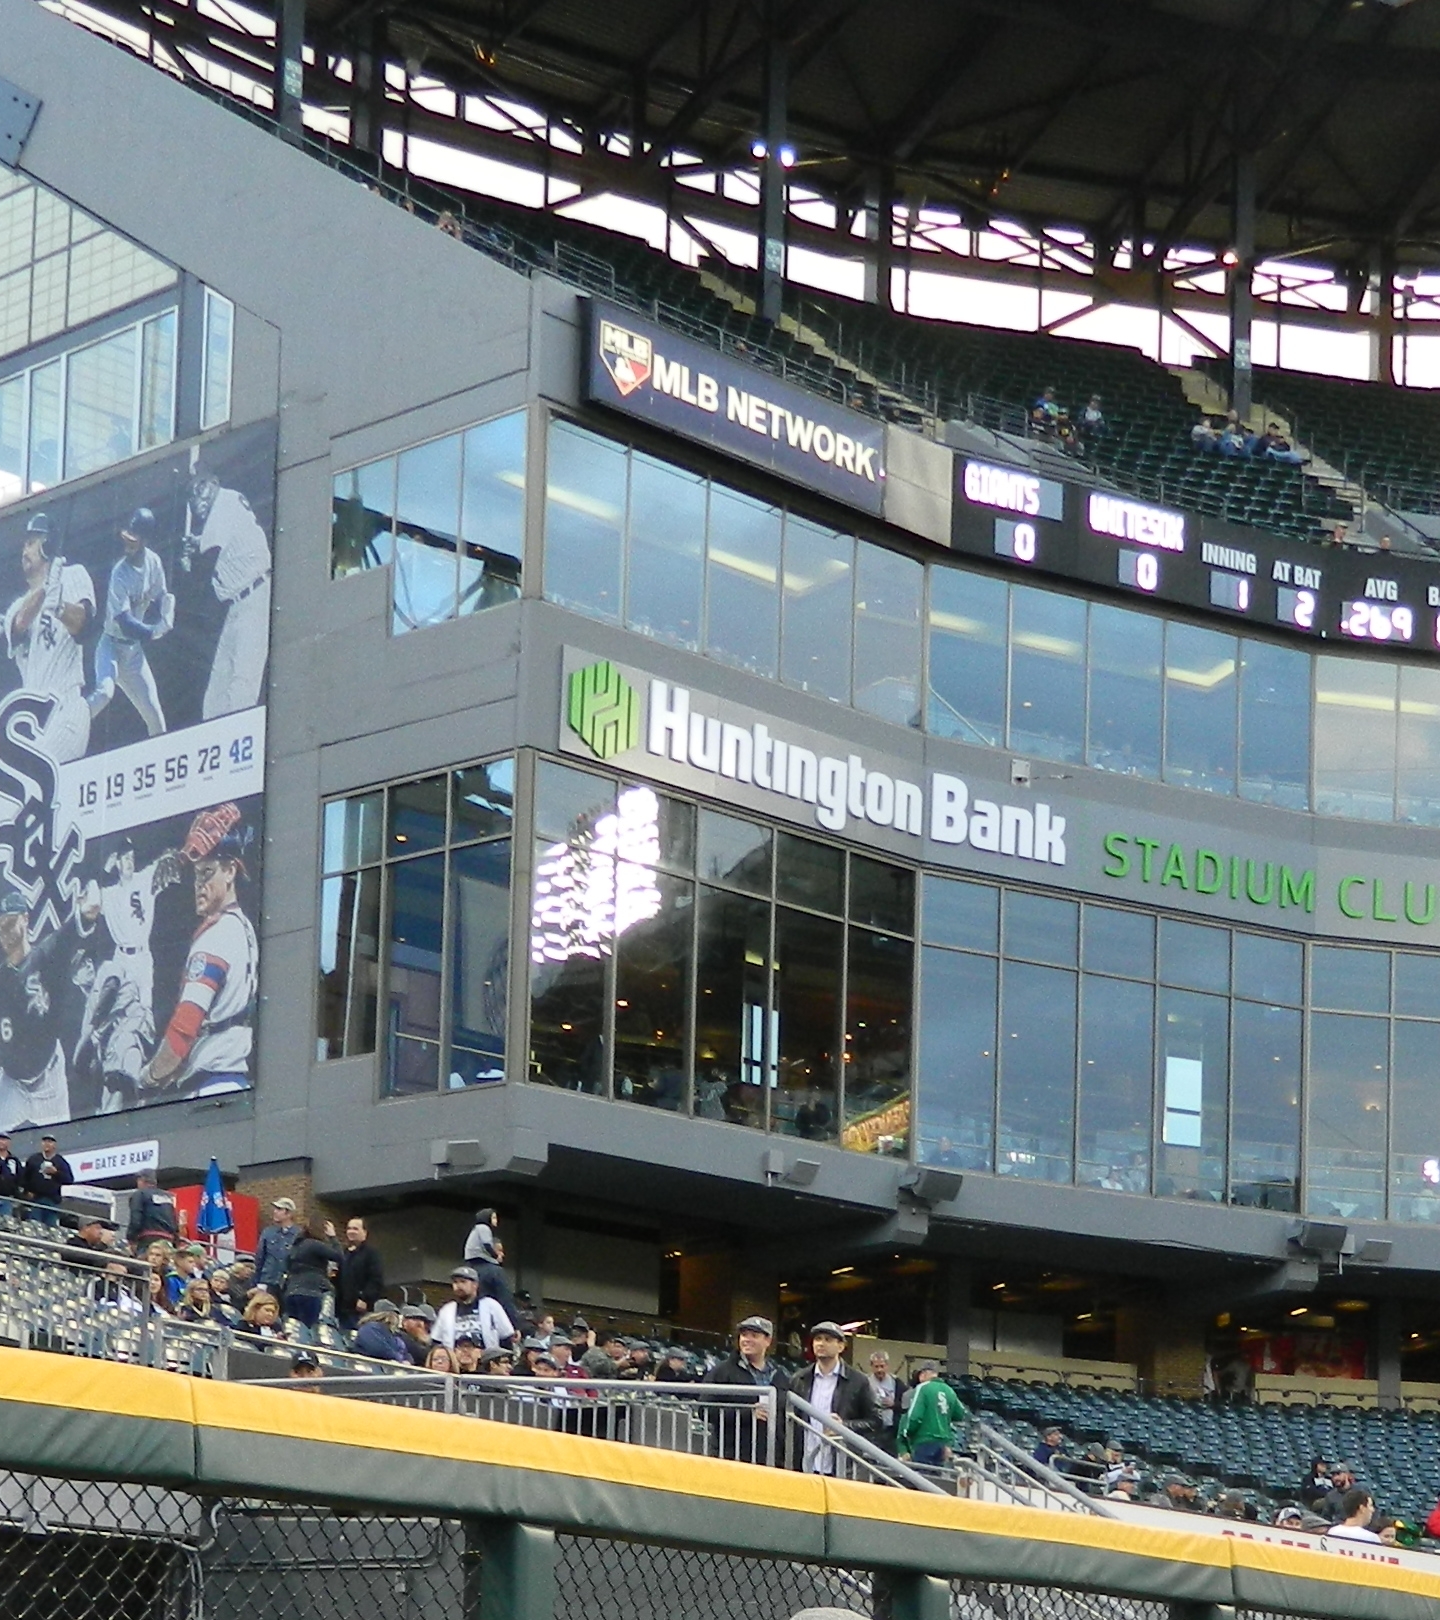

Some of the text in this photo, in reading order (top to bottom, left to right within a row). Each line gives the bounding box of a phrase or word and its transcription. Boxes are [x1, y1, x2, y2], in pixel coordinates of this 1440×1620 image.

[652, 354, 876, 483] MLB NETWORK
[964, 462, 1041, 516] GIANTS
[1201, 542, 1257, 574] INNING
[1273, 560, 1322, 590] AT BAT
[1364, 577, 1399, 602] AVG
[78, 735, 254, 808] 16 19 35 56 72 42
[647, 678, 1067, 866] Huntington Bank
[1103, 830, 1317, 918] STADIUM
[95, 1150, 154, 1170] GATE 2 RAMP
